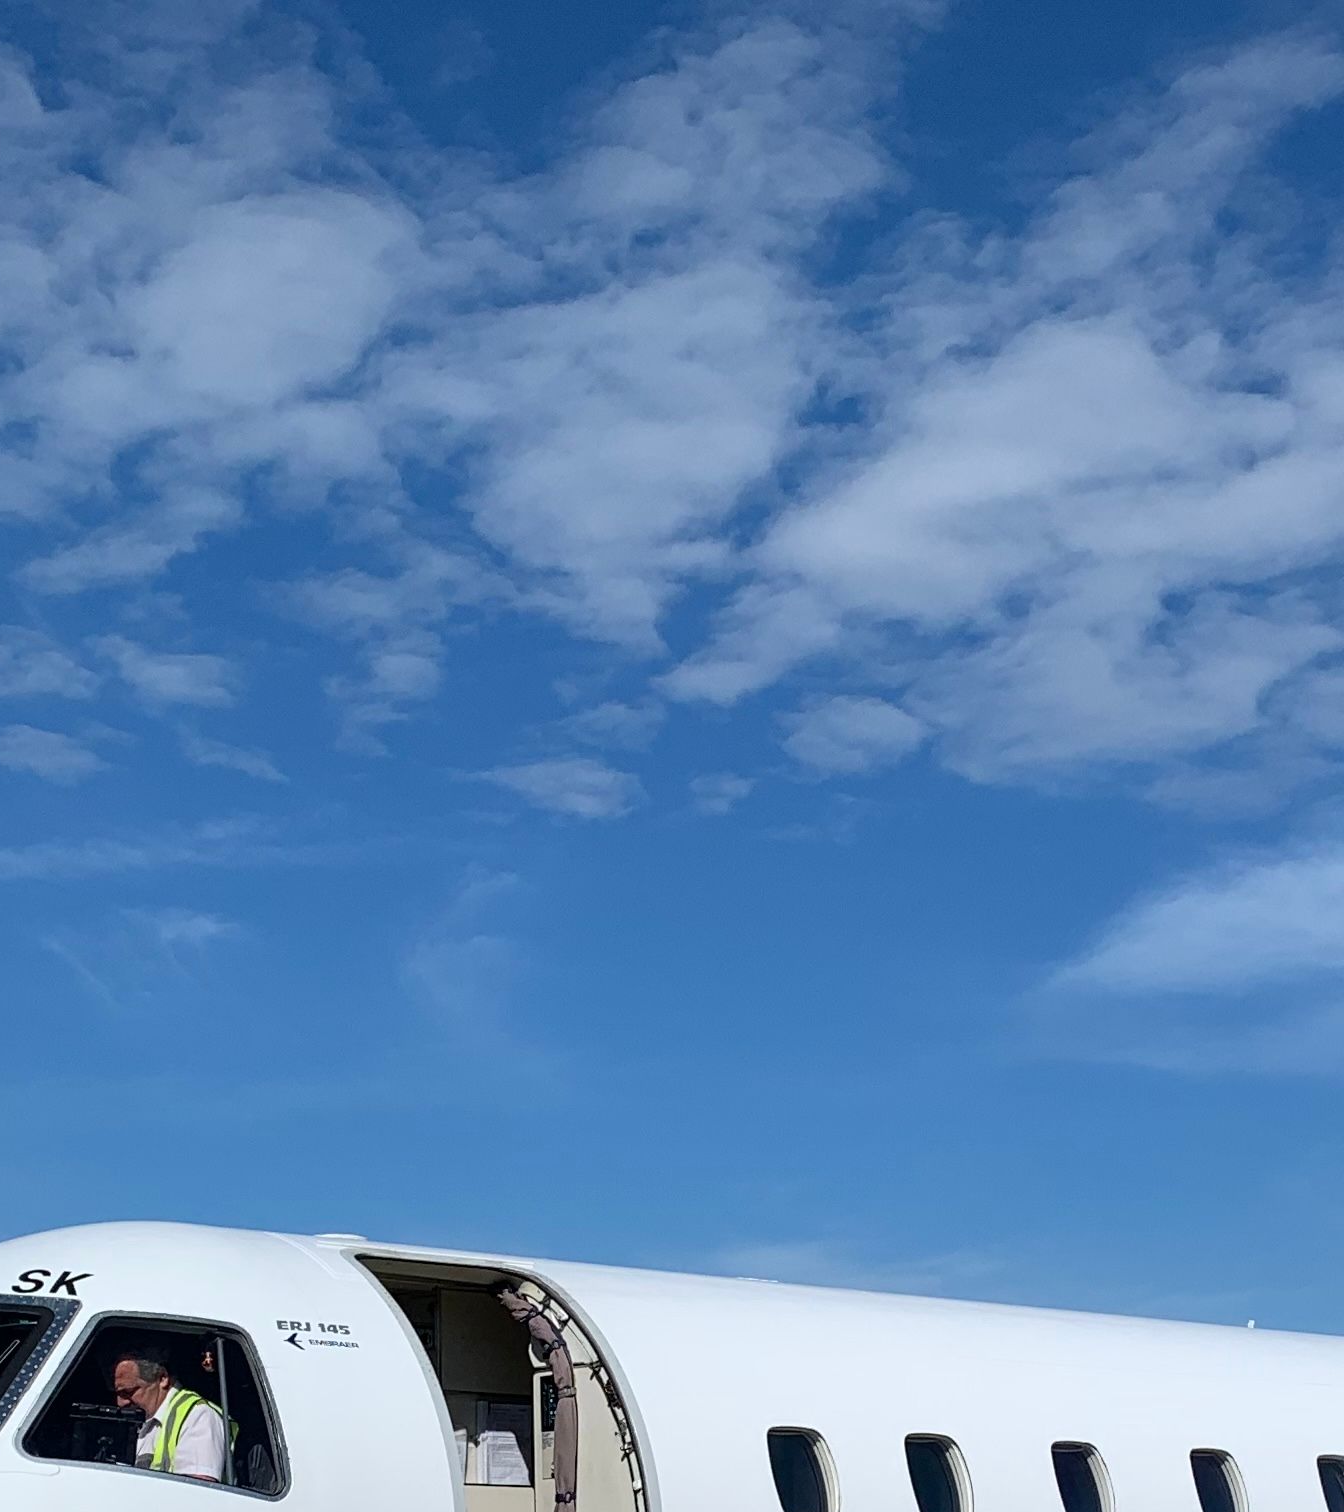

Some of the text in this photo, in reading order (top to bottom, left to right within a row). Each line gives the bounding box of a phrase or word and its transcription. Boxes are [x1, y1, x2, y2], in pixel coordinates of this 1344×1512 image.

[11, 1269, 94, 1296] SK
[276, 1320, 351, 1335] ERJ 145
